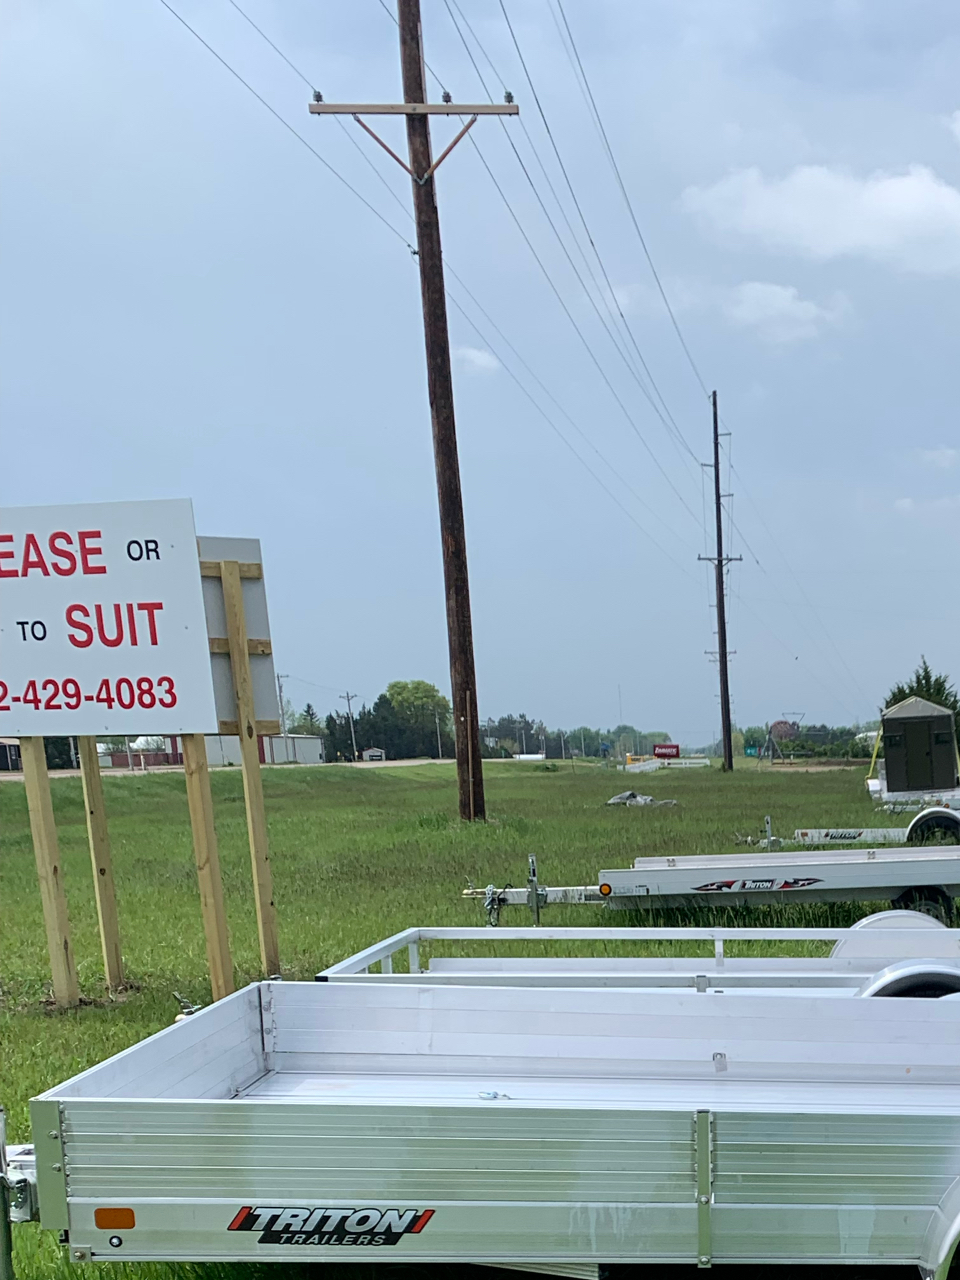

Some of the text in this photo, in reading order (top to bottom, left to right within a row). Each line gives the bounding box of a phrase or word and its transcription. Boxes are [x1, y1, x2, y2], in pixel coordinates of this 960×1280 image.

[126, 540, 161, 561] OR
[16, 602, 164, 648] TO SUIT
[250, 1206, 418, 1233] TRITON
[279, 1233, 386, 1245] TRAILERS
